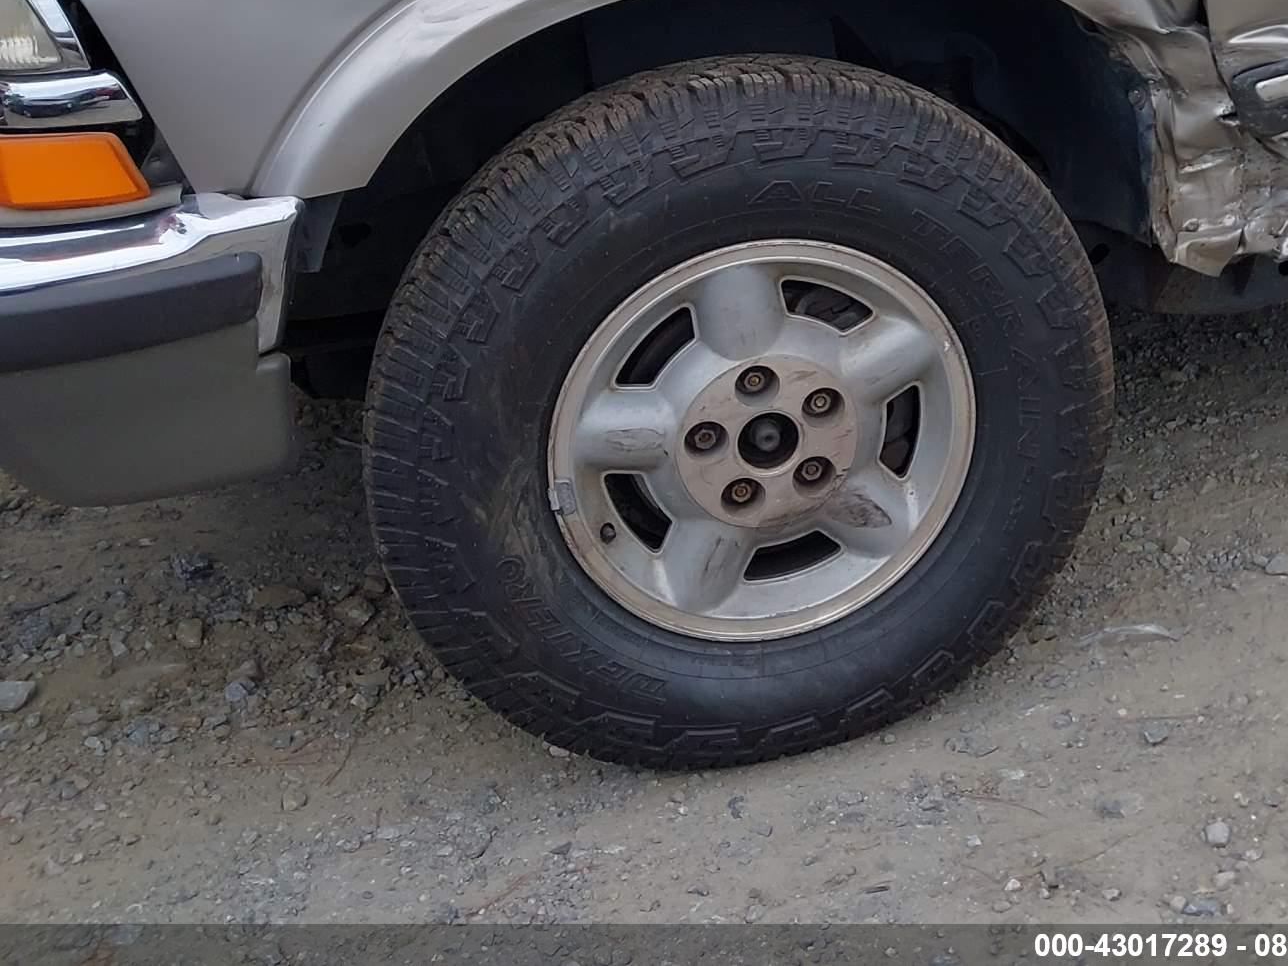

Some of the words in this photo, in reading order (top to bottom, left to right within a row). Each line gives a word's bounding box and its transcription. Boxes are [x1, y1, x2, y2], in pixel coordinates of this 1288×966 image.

[746, 179, 882, 213] ALL
[911, 208, 1043, 460] TERRAIN
[495, 554, 668, 704] DEXTERO
